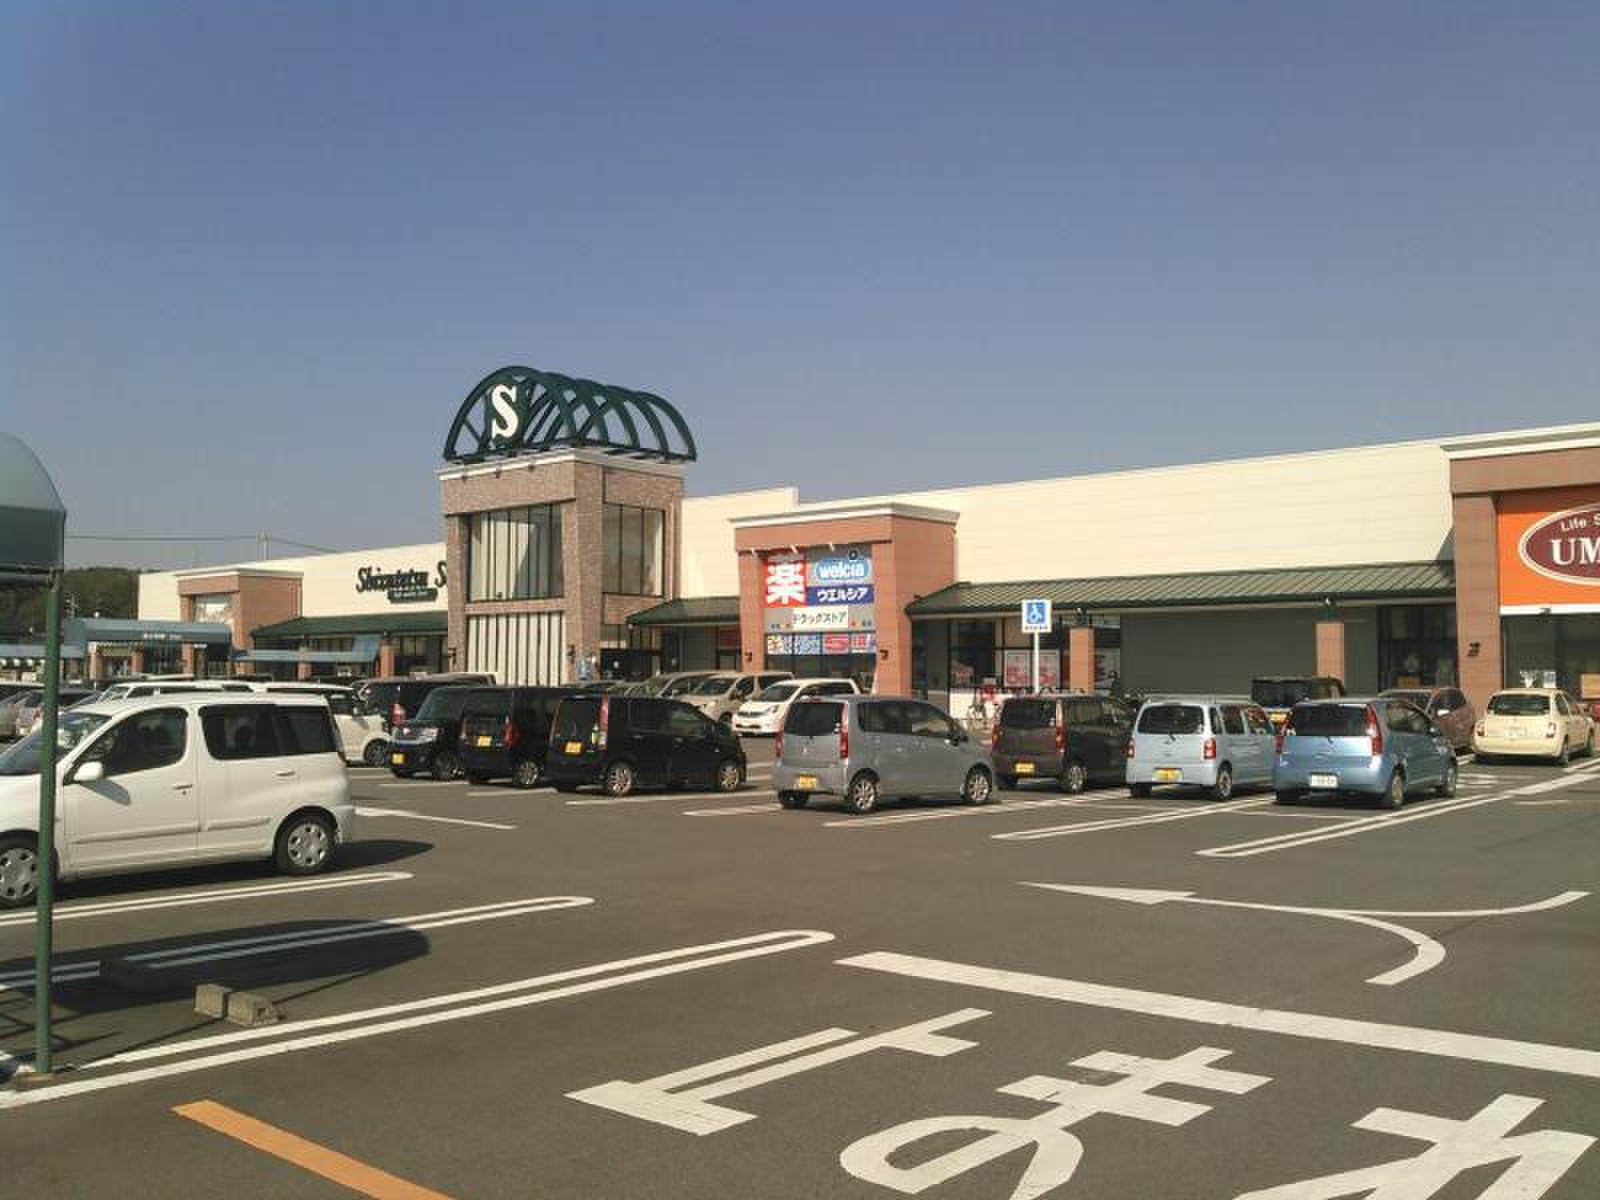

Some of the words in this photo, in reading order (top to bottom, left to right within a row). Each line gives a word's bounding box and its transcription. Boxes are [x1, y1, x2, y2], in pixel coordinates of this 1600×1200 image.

[491, 384, 518, 438] S
[766, 564, 805, 605] 薬
[819, 561, 865, 579] welcia
[817, 587, 868, 602] ウエルシア
